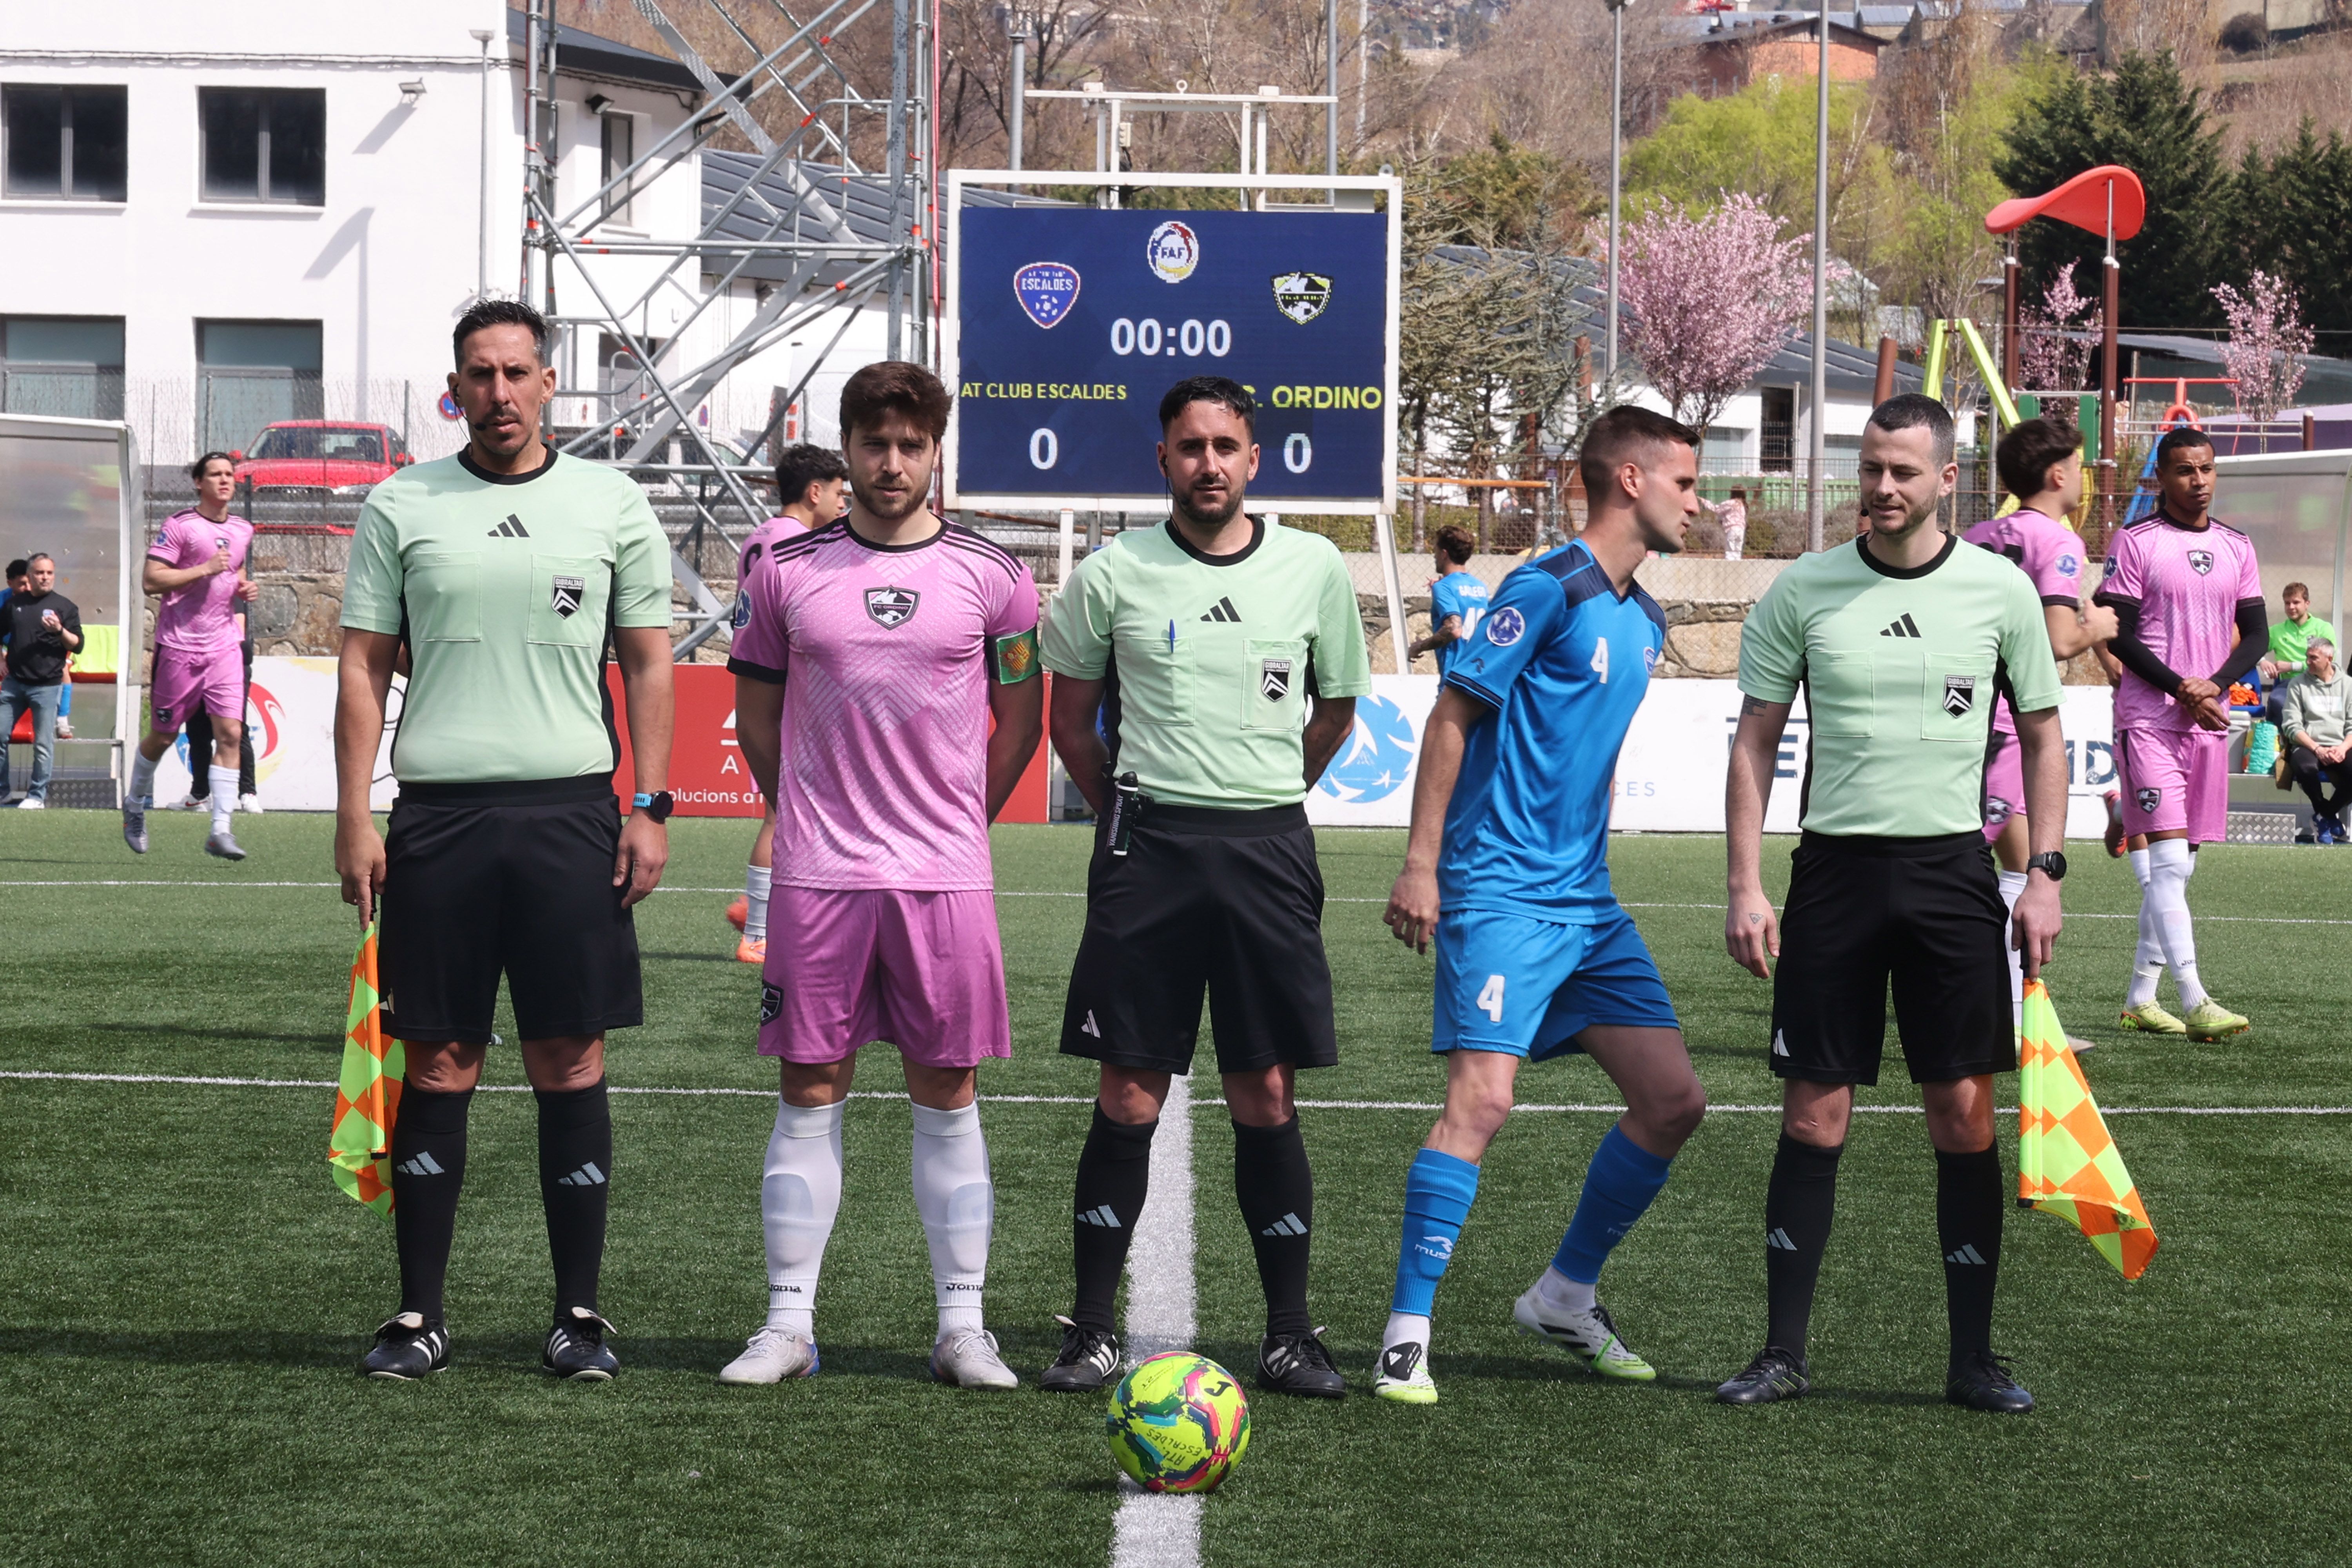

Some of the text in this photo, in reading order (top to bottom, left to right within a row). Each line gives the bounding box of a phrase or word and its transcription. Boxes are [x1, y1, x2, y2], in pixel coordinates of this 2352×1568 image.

[1161, 247, 1185, 259] FAF
[1022, 278, 1073, 290] ESCALDES
[1110, 318, 1232, 357] 00:00
[960, 383, 1127, 400] AT CLUB ESCALDES
[1272, 385, 1382, 409] ORDINO
[1029, 428, 1058, 470] 0
[1283, 433, 1312, 474] 0
[1590, 637, 1609, 684] 4
[1115, 794, 1124, 814] SPRAY
[1476, 975, 1505, 1022] 4
